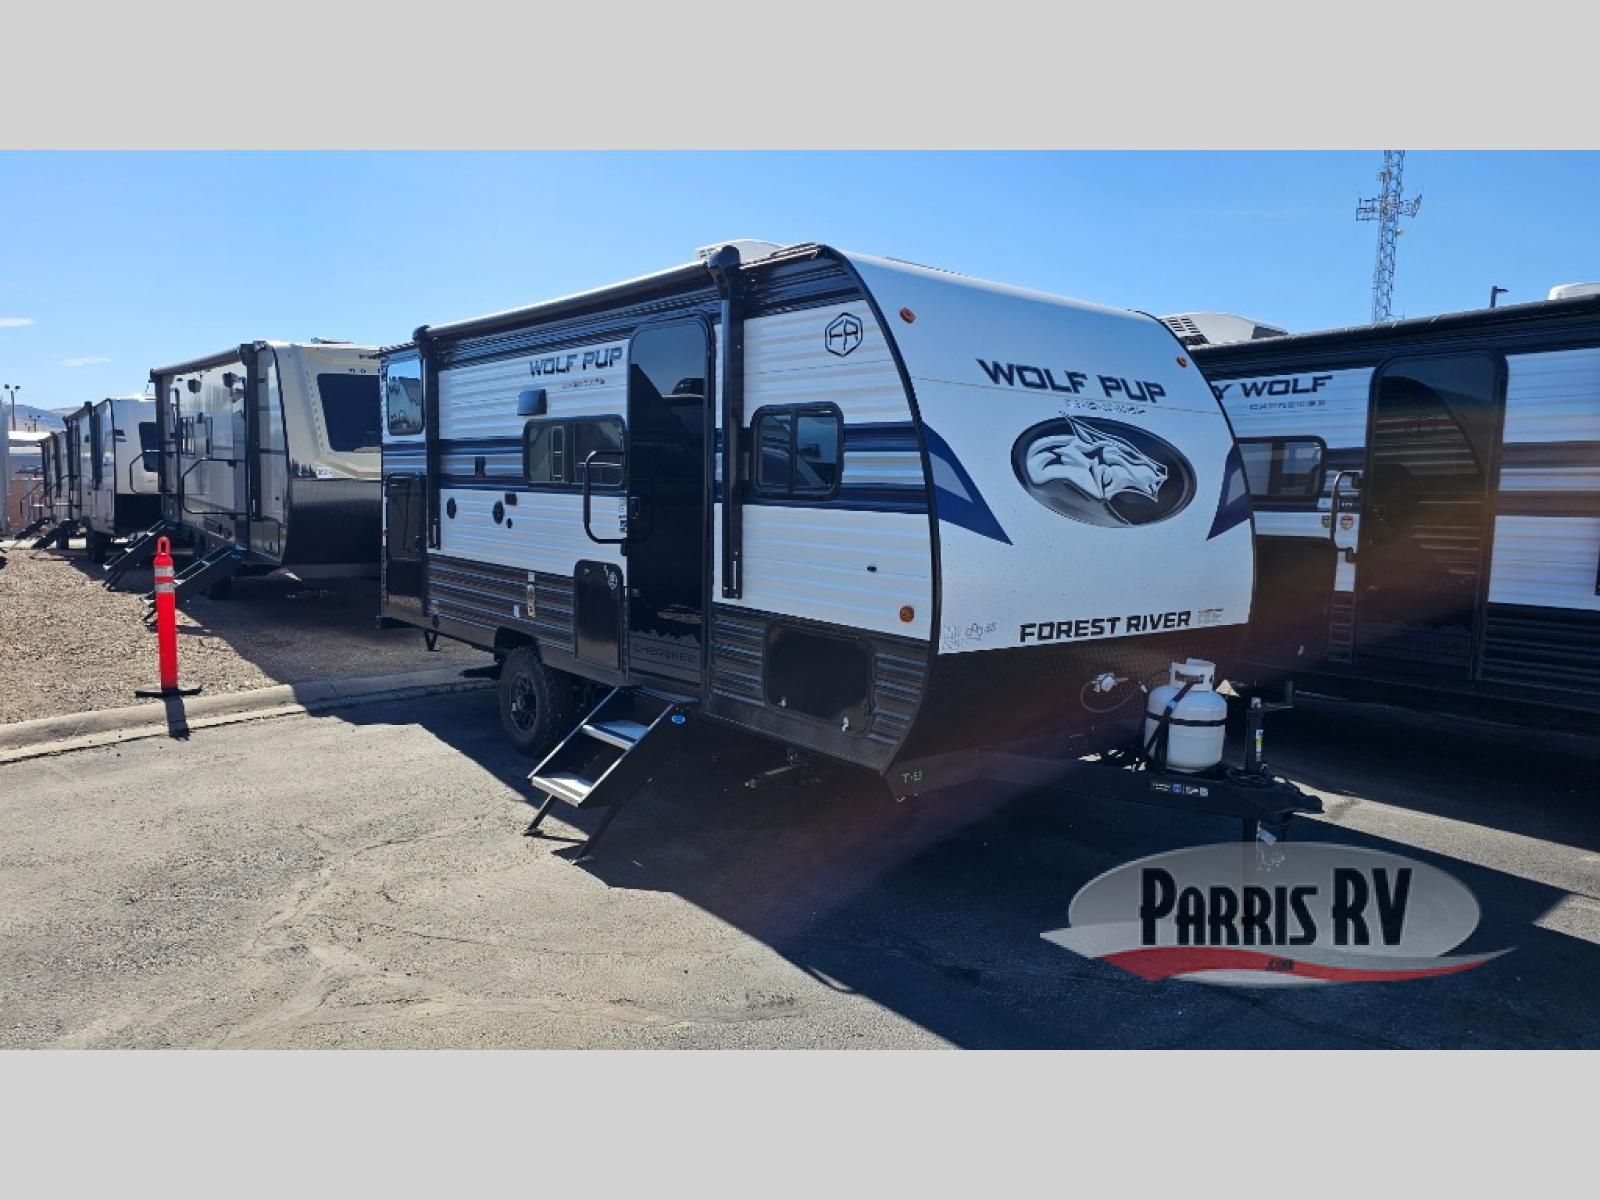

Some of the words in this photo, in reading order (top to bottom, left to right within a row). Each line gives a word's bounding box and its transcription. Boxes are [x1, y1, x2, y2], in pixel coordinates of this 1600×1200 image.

[529, 354, 578, 376] WOLF
[582, 347, 622, 370] PUP
[976, 358, 1088, 394] WOLF
[1096, 374, 1167, 404] PUP
[1240, 374, 1333, 398] WOLF
[1019, 617, 1121, 646] FOREST
[1126, 610, 1192, 637] RIVER
